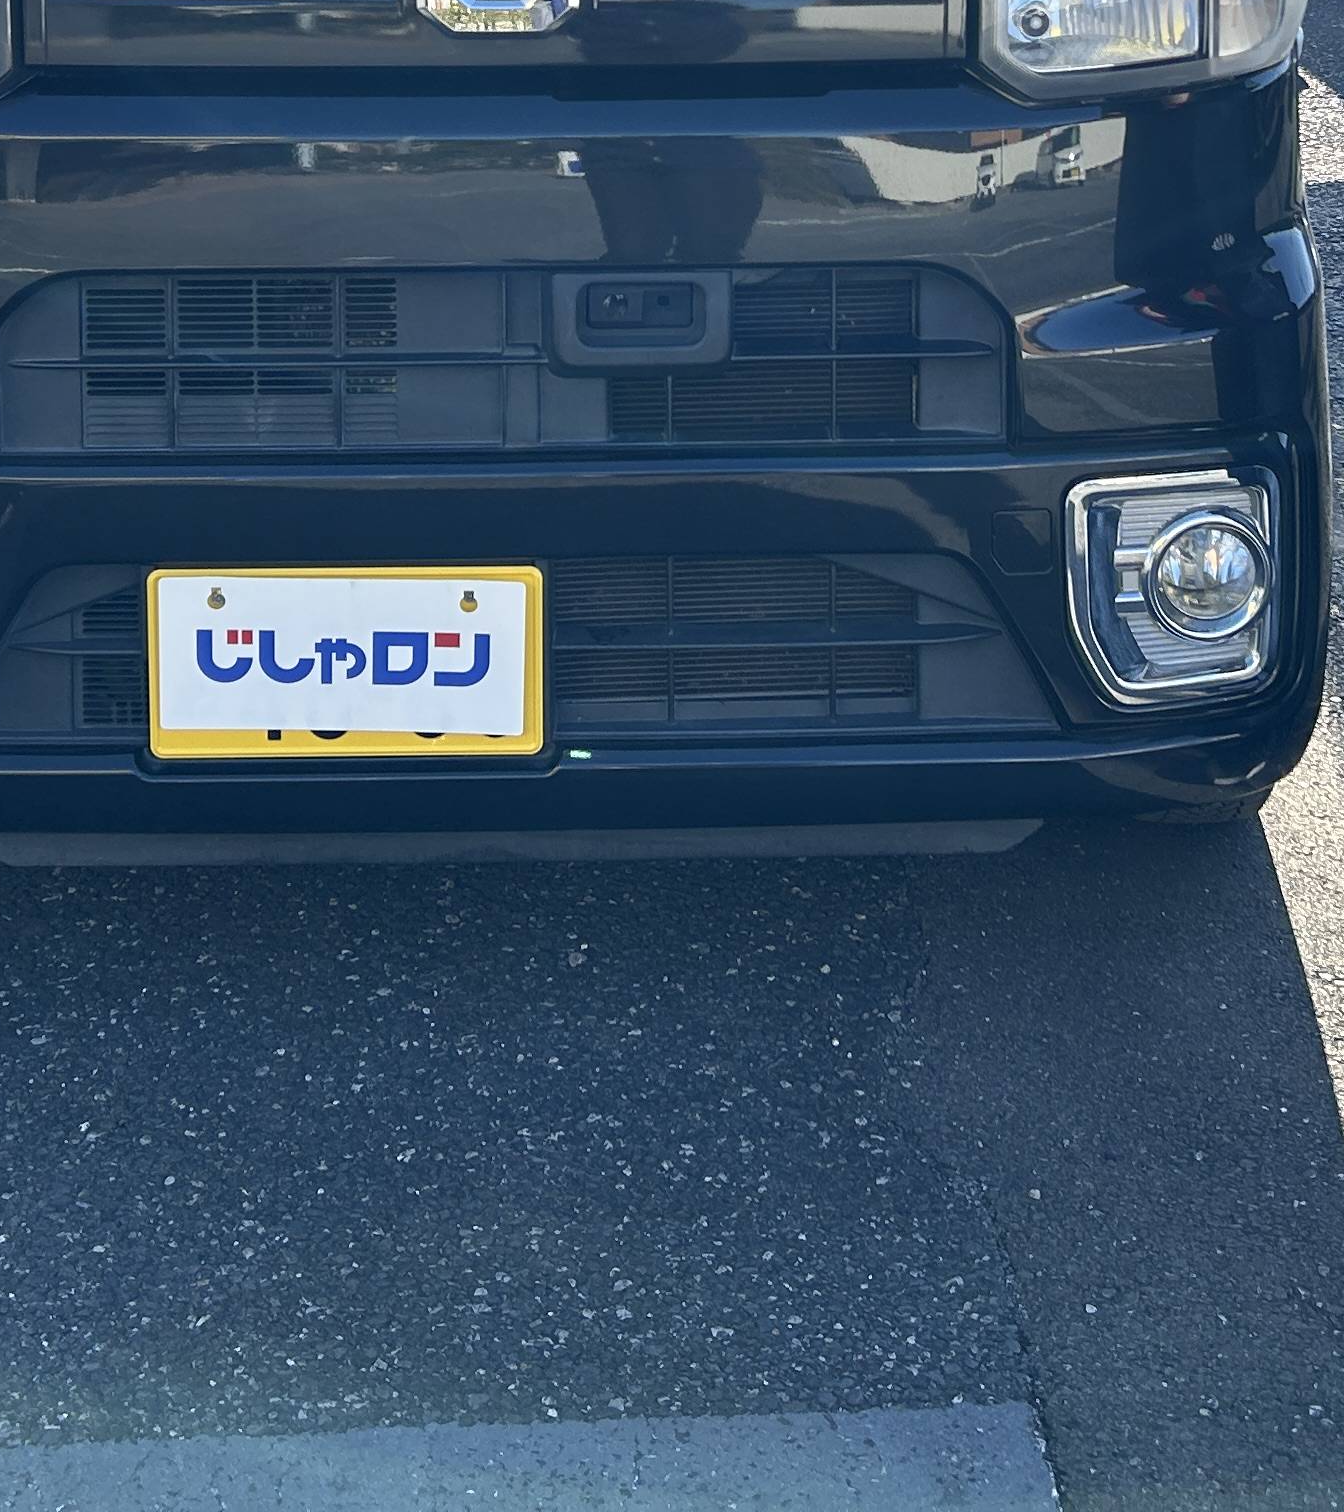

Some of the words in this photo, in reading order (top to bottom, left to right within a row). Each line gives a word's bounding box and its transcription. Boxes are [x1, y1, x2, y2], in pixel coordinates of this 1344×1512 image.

[196, 629, 491, 687] じしゃロン
